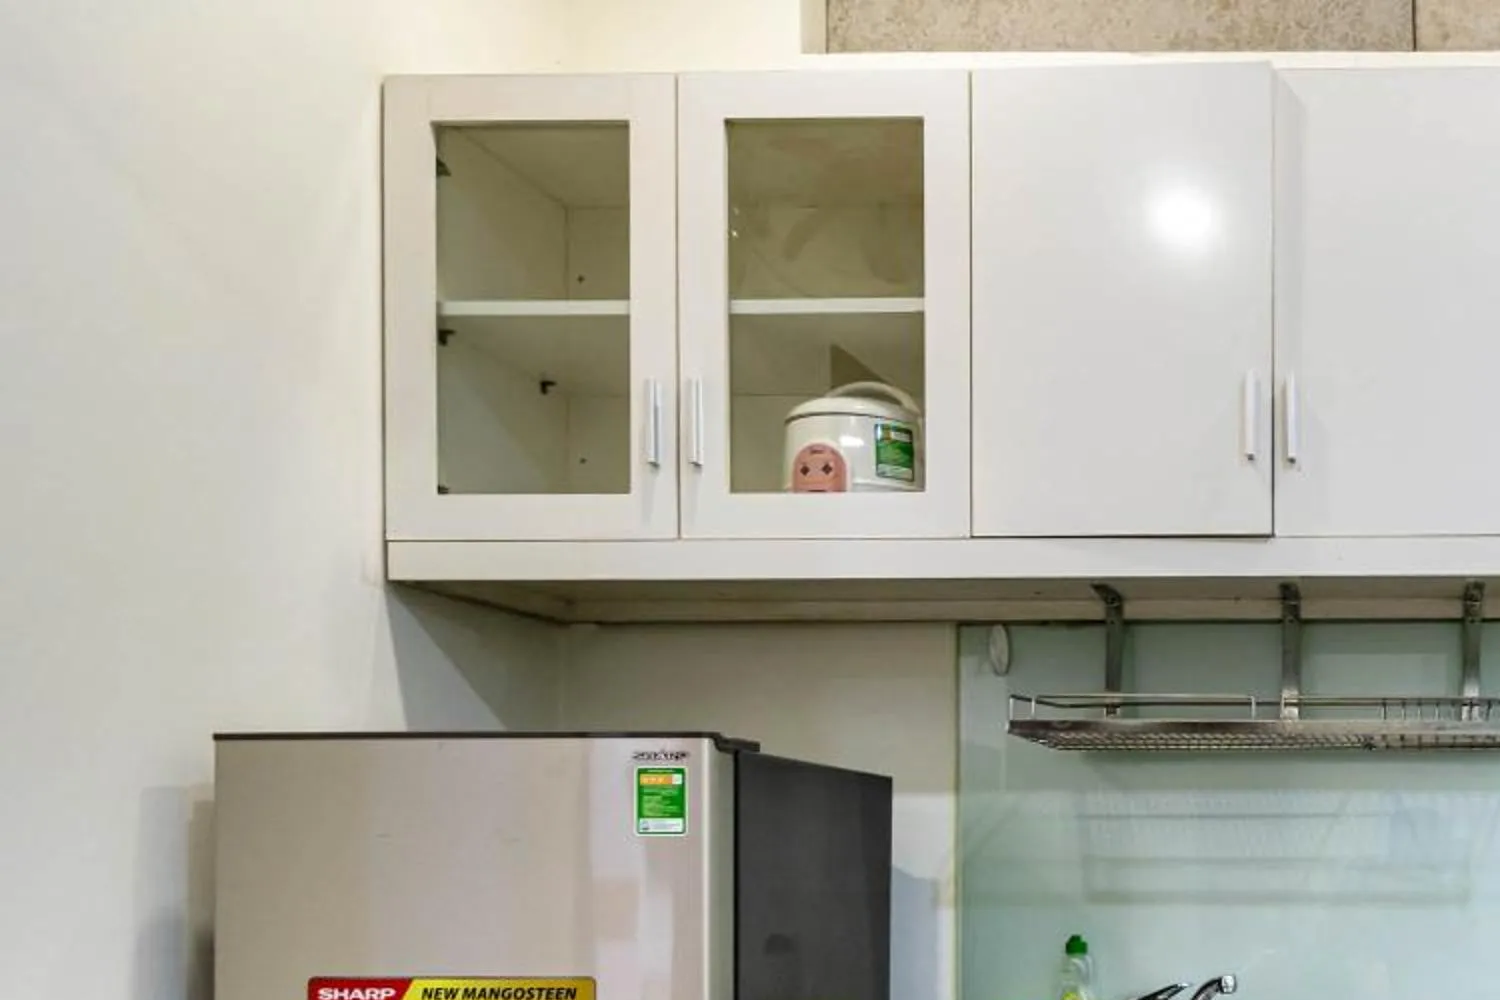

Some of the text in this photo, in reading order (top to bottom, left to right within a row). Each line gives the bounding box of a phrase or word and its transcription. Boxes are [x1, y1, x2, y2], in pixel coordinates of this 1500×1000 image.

[318, 987, 396, 1000] SHARP
[421, 987, 577, 1000] NEW MANGOSTEEN
